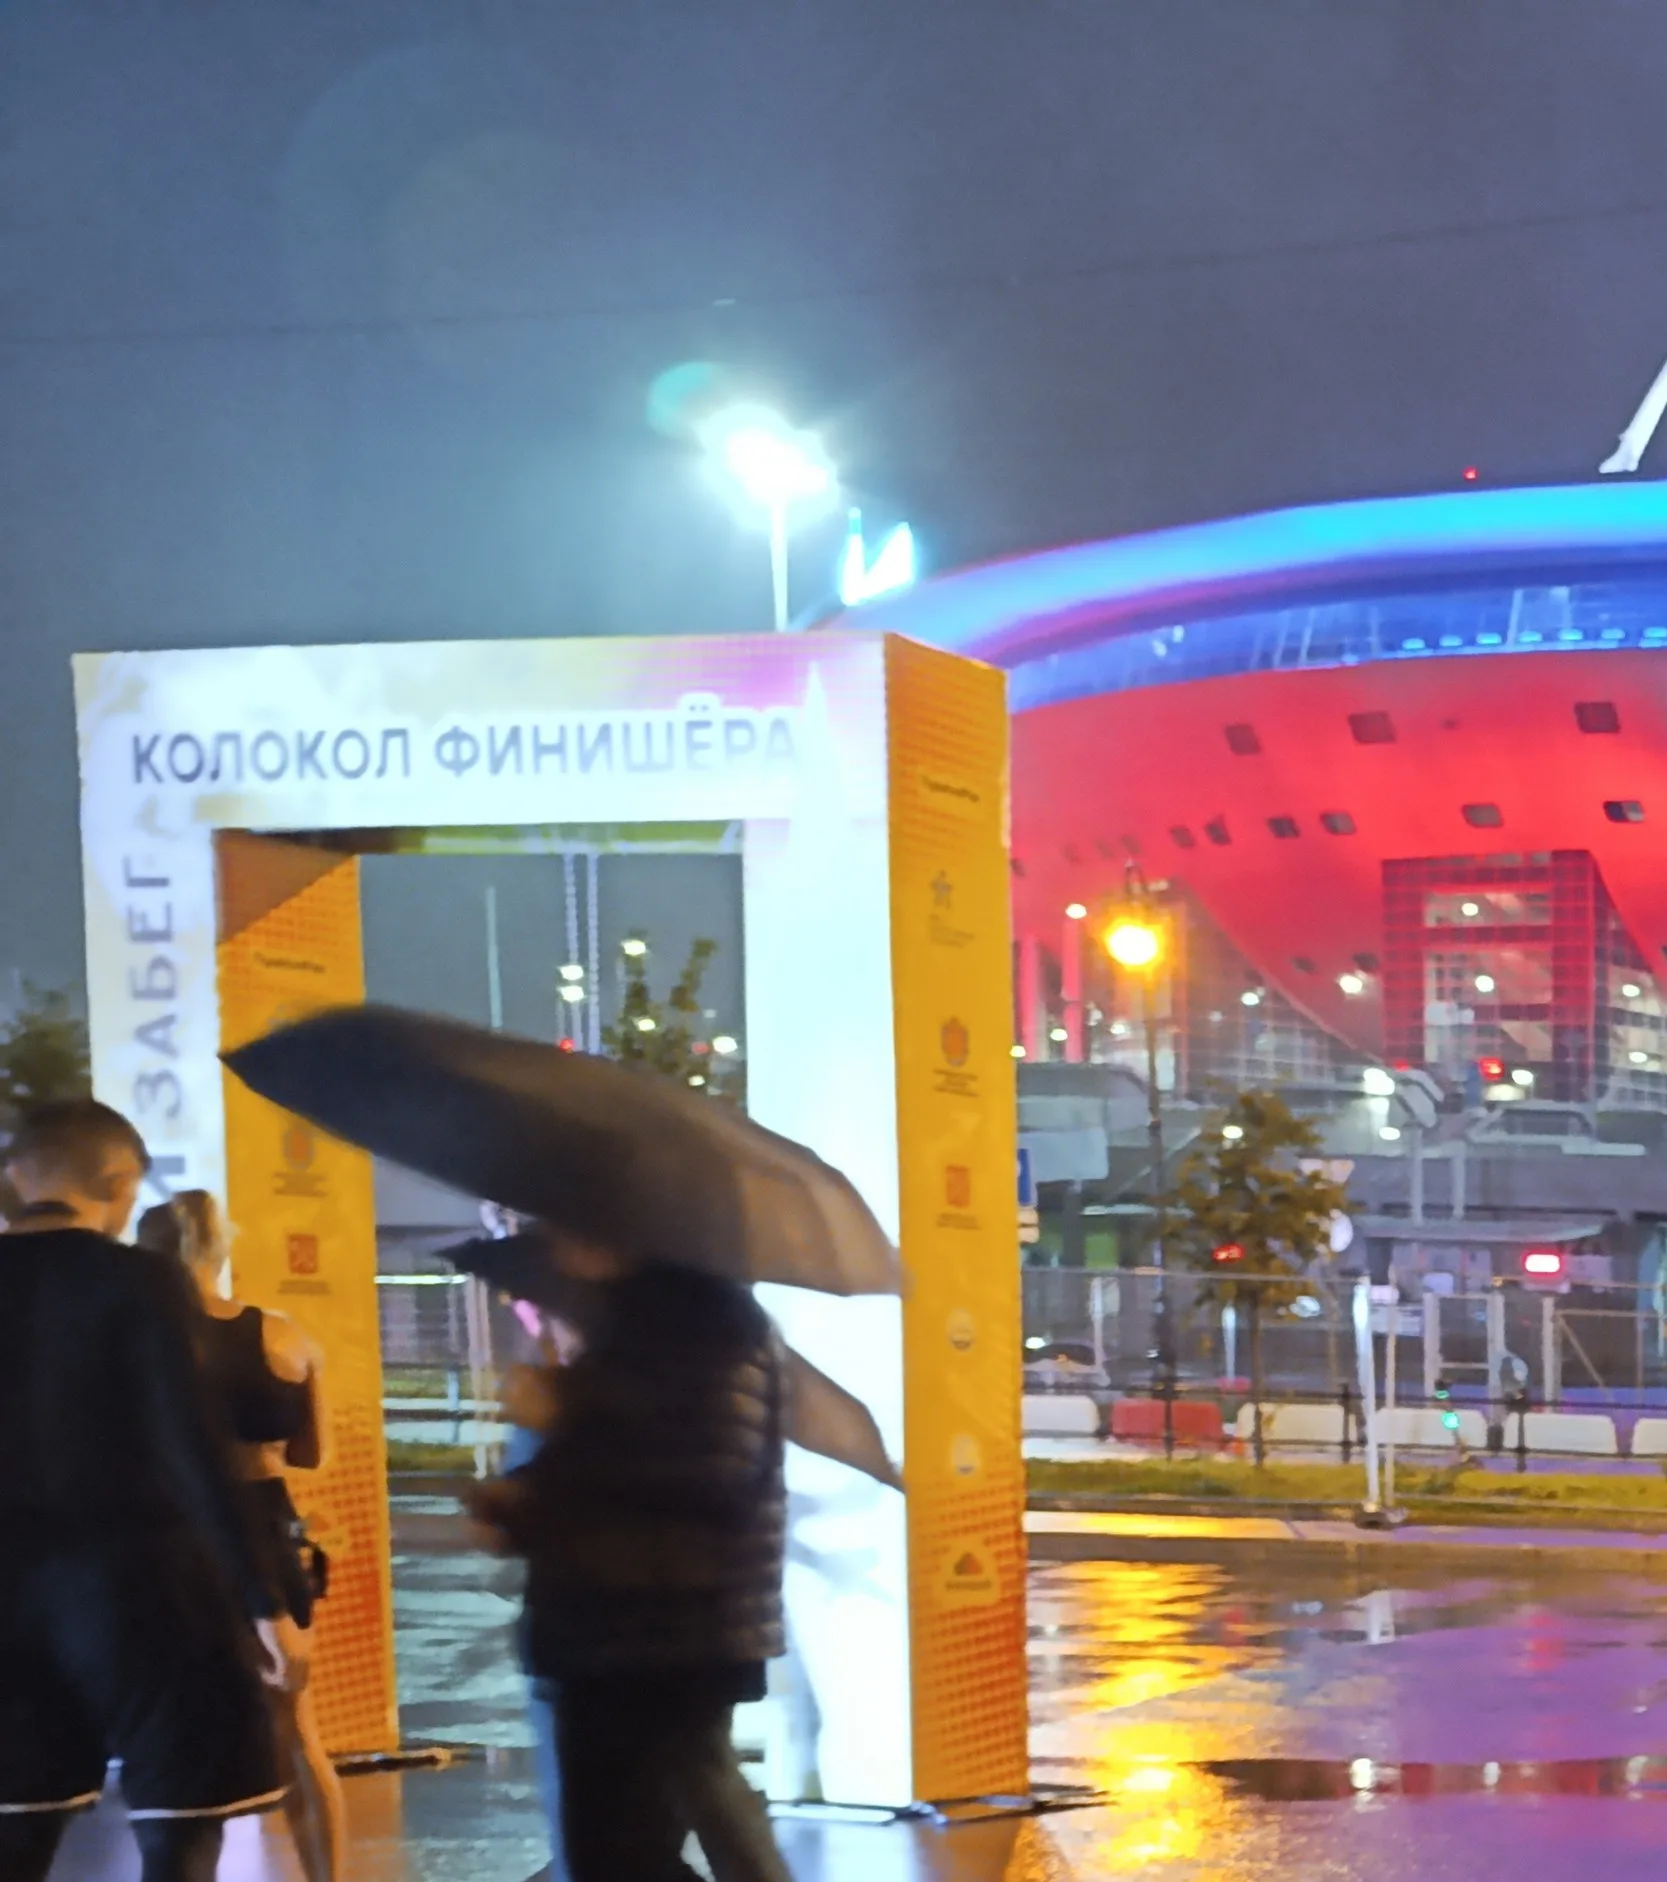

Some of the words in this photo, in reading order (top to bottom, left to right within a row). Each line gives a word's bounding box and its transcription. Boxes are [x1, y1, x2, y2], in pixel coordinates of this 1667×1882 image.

[132, 728, 412, 784] КОЛОКОЛ
[433, 703, 797, 778] ФИНИШЁРА
[123, 853, 184, 1120] ЗАБЕГ
